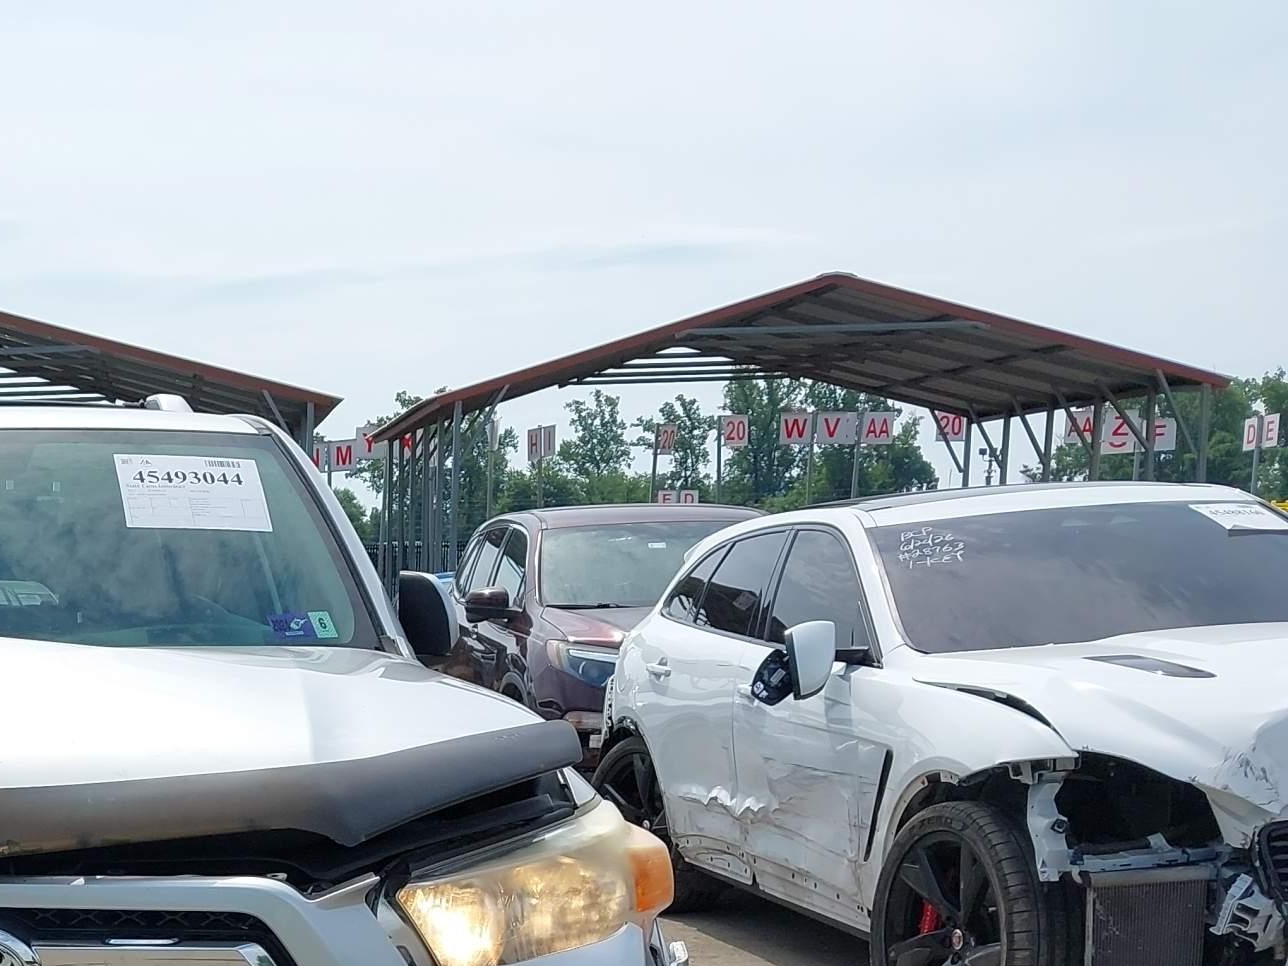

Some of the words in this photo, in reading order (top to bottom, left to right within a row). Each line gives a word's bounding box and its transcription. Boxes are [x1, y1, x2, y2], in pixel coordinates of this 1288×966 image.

[725, 420, 746, 441] 20
[784, 418, 808, 439] W
[824, 418, 841, 438] V
[866, 418, 890, 439] AA
[1247, 424, 1256, 444] D
[1266, 421, 1275, 441] E
[363, 433, 376, 453] Y
[530, 431, 538, 453] H
[662, 430, 675, 450] 20
[336, 446, 352, 466] M
[132, 469, 244, 487] 45493044
[318, 617, 328, 630] 6
